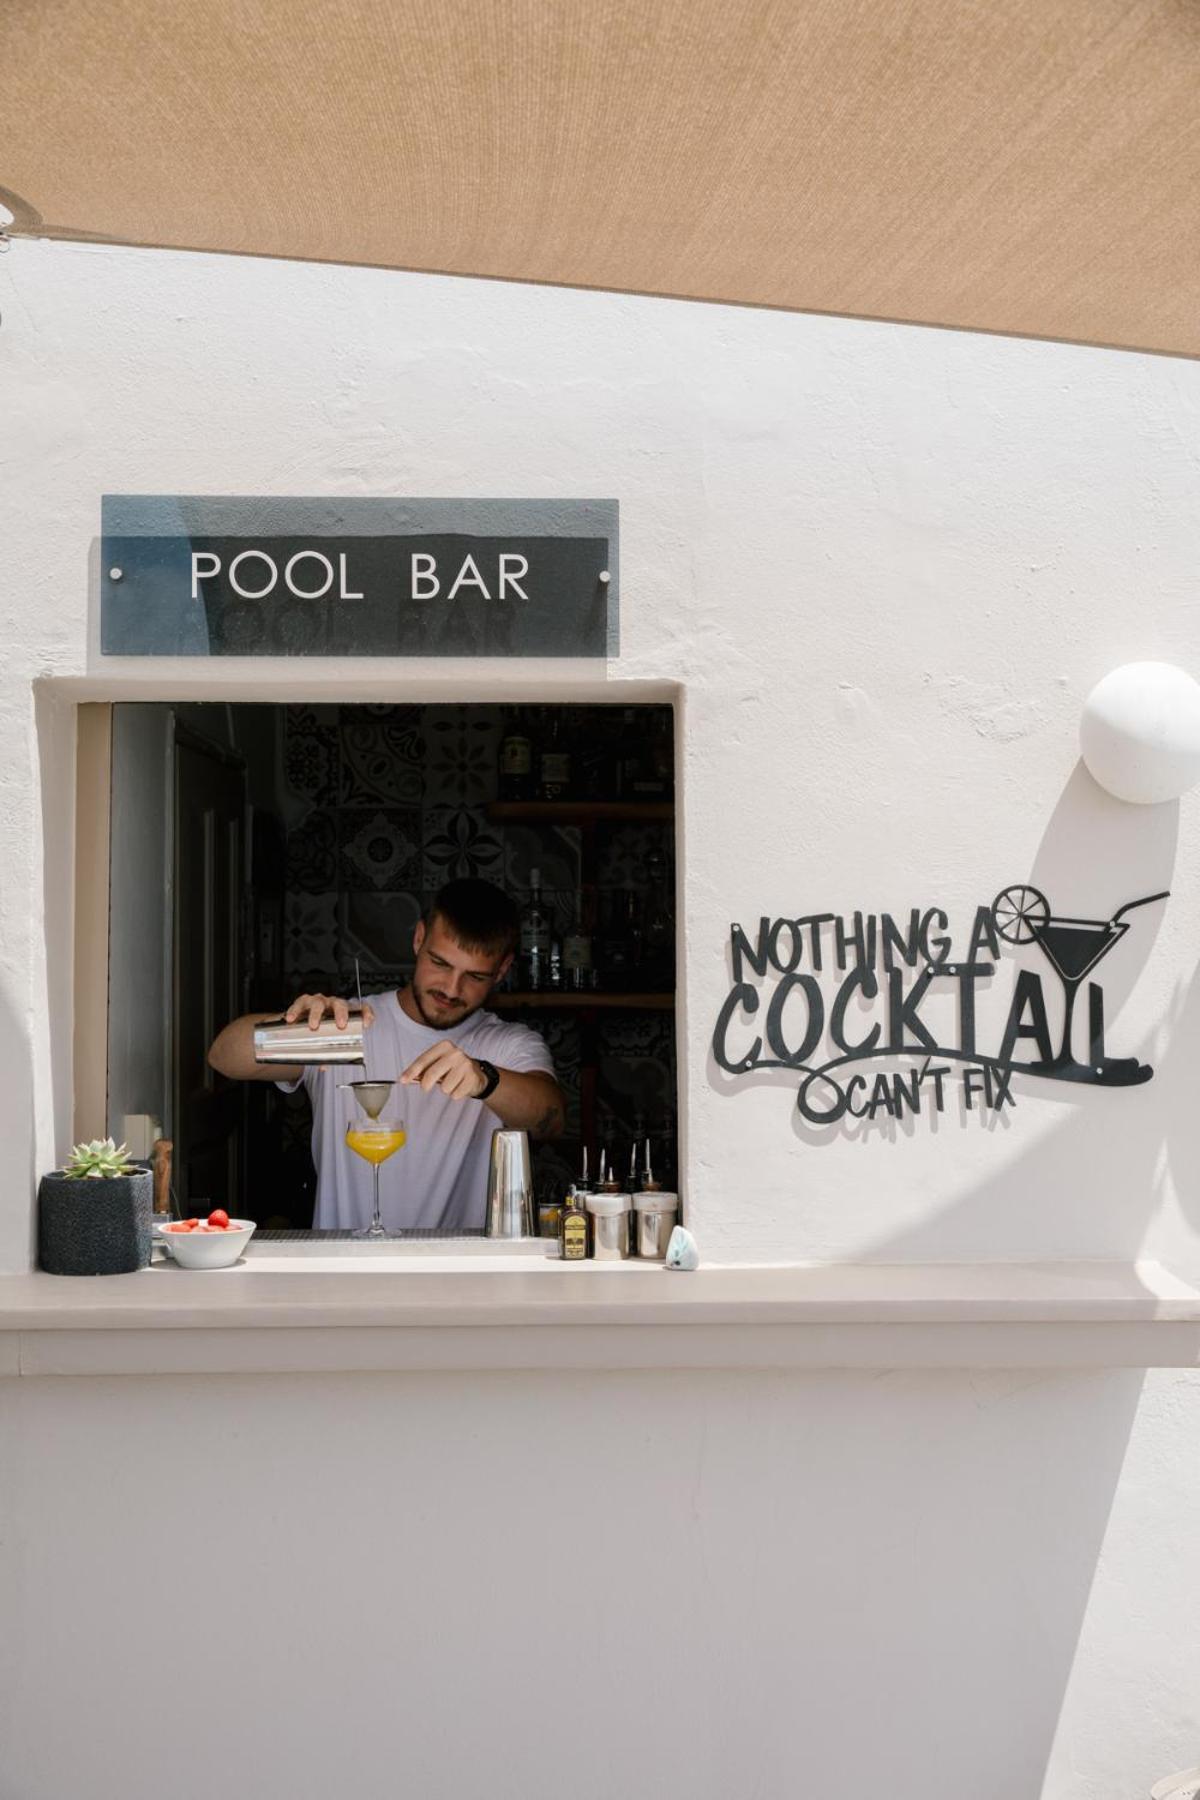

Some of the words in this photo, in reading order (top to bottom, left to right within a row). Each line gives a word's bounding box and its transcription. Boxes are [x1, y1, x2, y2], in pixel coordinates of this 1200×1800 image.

[191, 550, 364, 600] POOL
[411, 553, 529, 600] BAR
[731, 907, 951, 983] NOTHING
[968, 906, 1001, 965] A
[713, 962, 1154, 1086] COCKTAIL
[845, 1056, 951, 1119] CAN'T
[963, 1064, 1016, 1112] FIX
